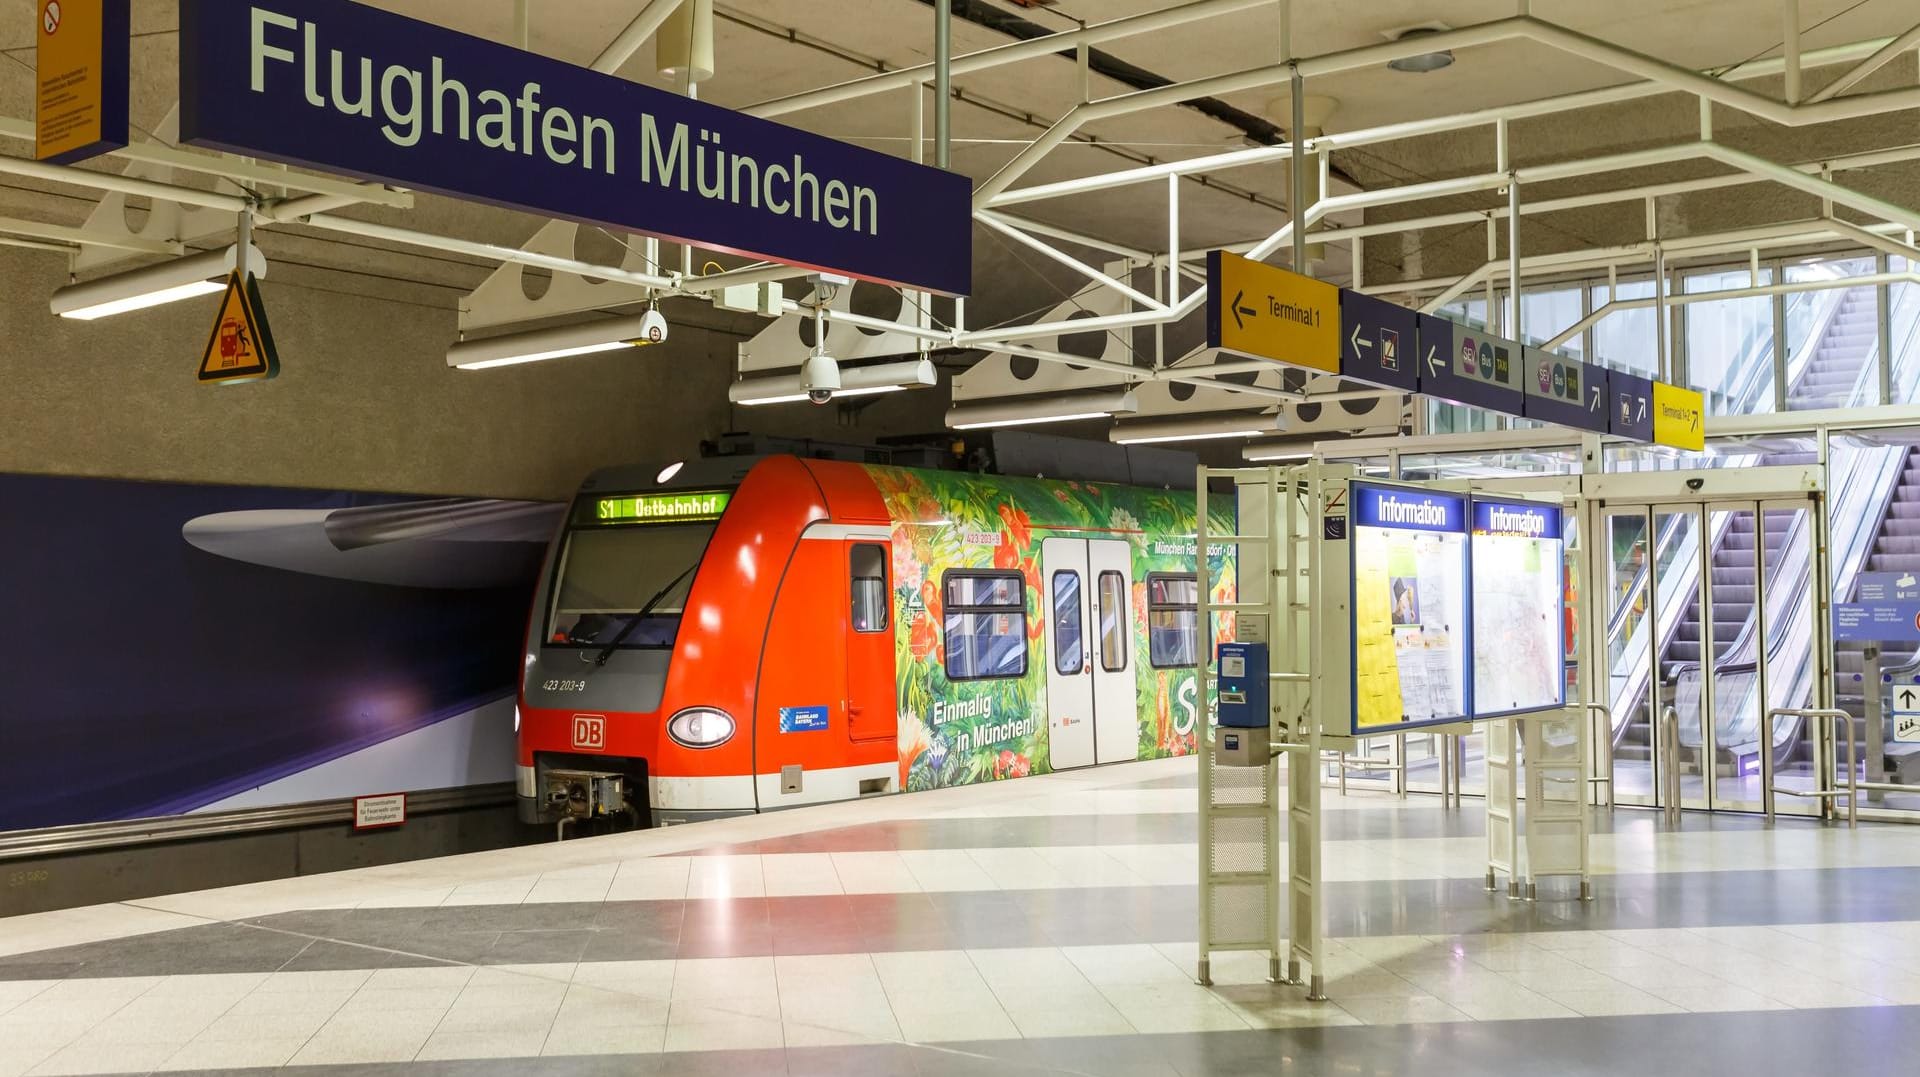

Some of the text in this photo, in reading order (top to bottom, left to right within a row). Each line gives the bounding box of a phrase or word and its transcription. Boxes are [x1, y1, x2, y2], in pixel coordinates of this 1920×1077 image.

[251, 7, 878, 236] Flughafen München
[1267, 296, 1320, 328] Terminal 1
[1463, 347, 1477, 361] SEV
[1481, 354, 1492, 368] Bus
[600, 496, 717, 519] S1 Ostbahnhof
[1379, 495, 1446, 526] Information
[1490, 506, 1545, 533] Information
[1154, 541, 1185, 555] München
[543, 680, 586, 692] 423 203-9
[933, 693, 993, 726] Einmalig
[574, 718, 603, 745] DB
[956, 711, 1035, 754] in München!
